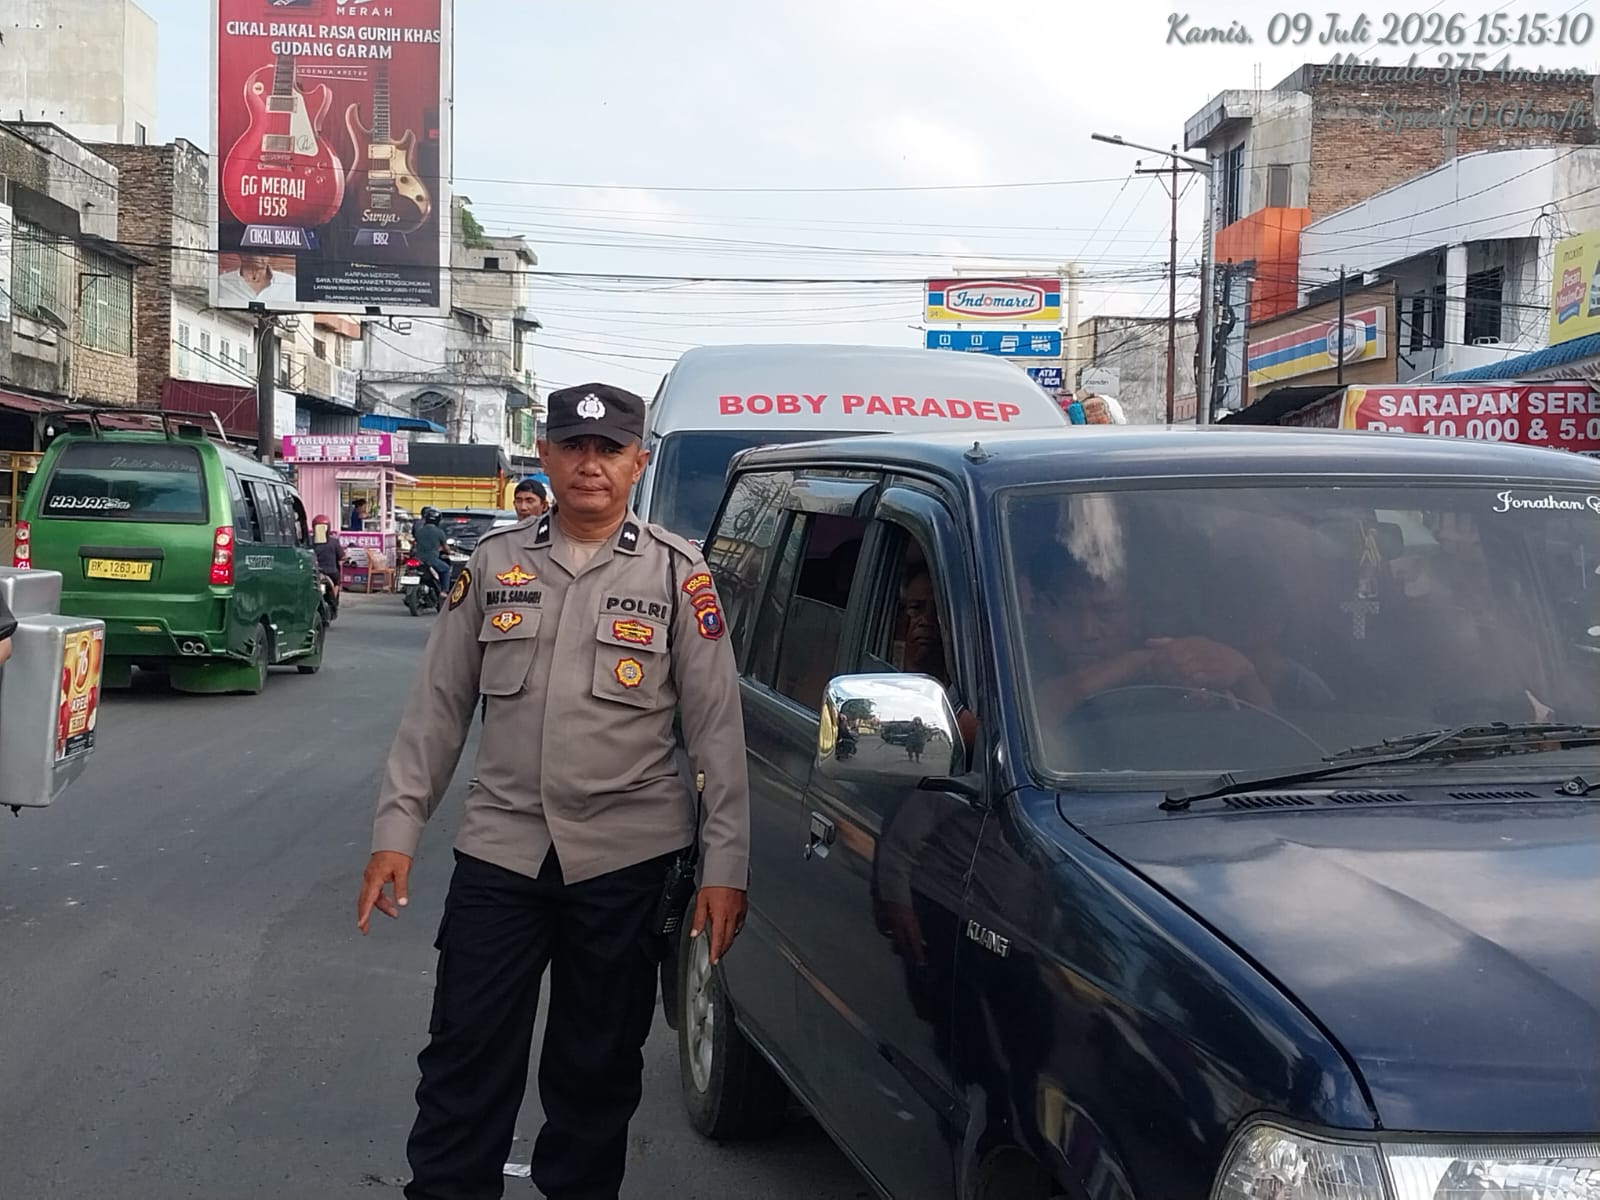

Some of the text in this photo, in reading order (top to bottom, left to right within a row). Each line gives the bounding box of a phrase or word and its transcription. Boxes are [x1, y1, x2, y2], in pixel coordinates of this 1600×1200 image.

[336, 7, 393, 17] MERAH
[226, 21, 441, 43] CIKAL BAKAL RASA GURIH KHAS
[271, 41, 393, 59] GUDANG GARAM
[241, 175, 306, 201] GG MERAH
[258, 196, 288, 218] 1958
[361, 209, 401, 227] Surya
[250, 228, 302, 246] CIKAL BAKAL
[953, 291, 1035, 308] Indomaret
[1038, 369, 1057, 377] ATM
[1044, 377, 1060, 386] BCA
[718, 394, 1021, 423] BOBY PARADEP
[1379, 392, 1518, 417] SARAPAN
[1528, 419, 1548, 441] &
[1492, 490, 1585, 513] Jonathan
[606, 597, 668, 619] POLRI
